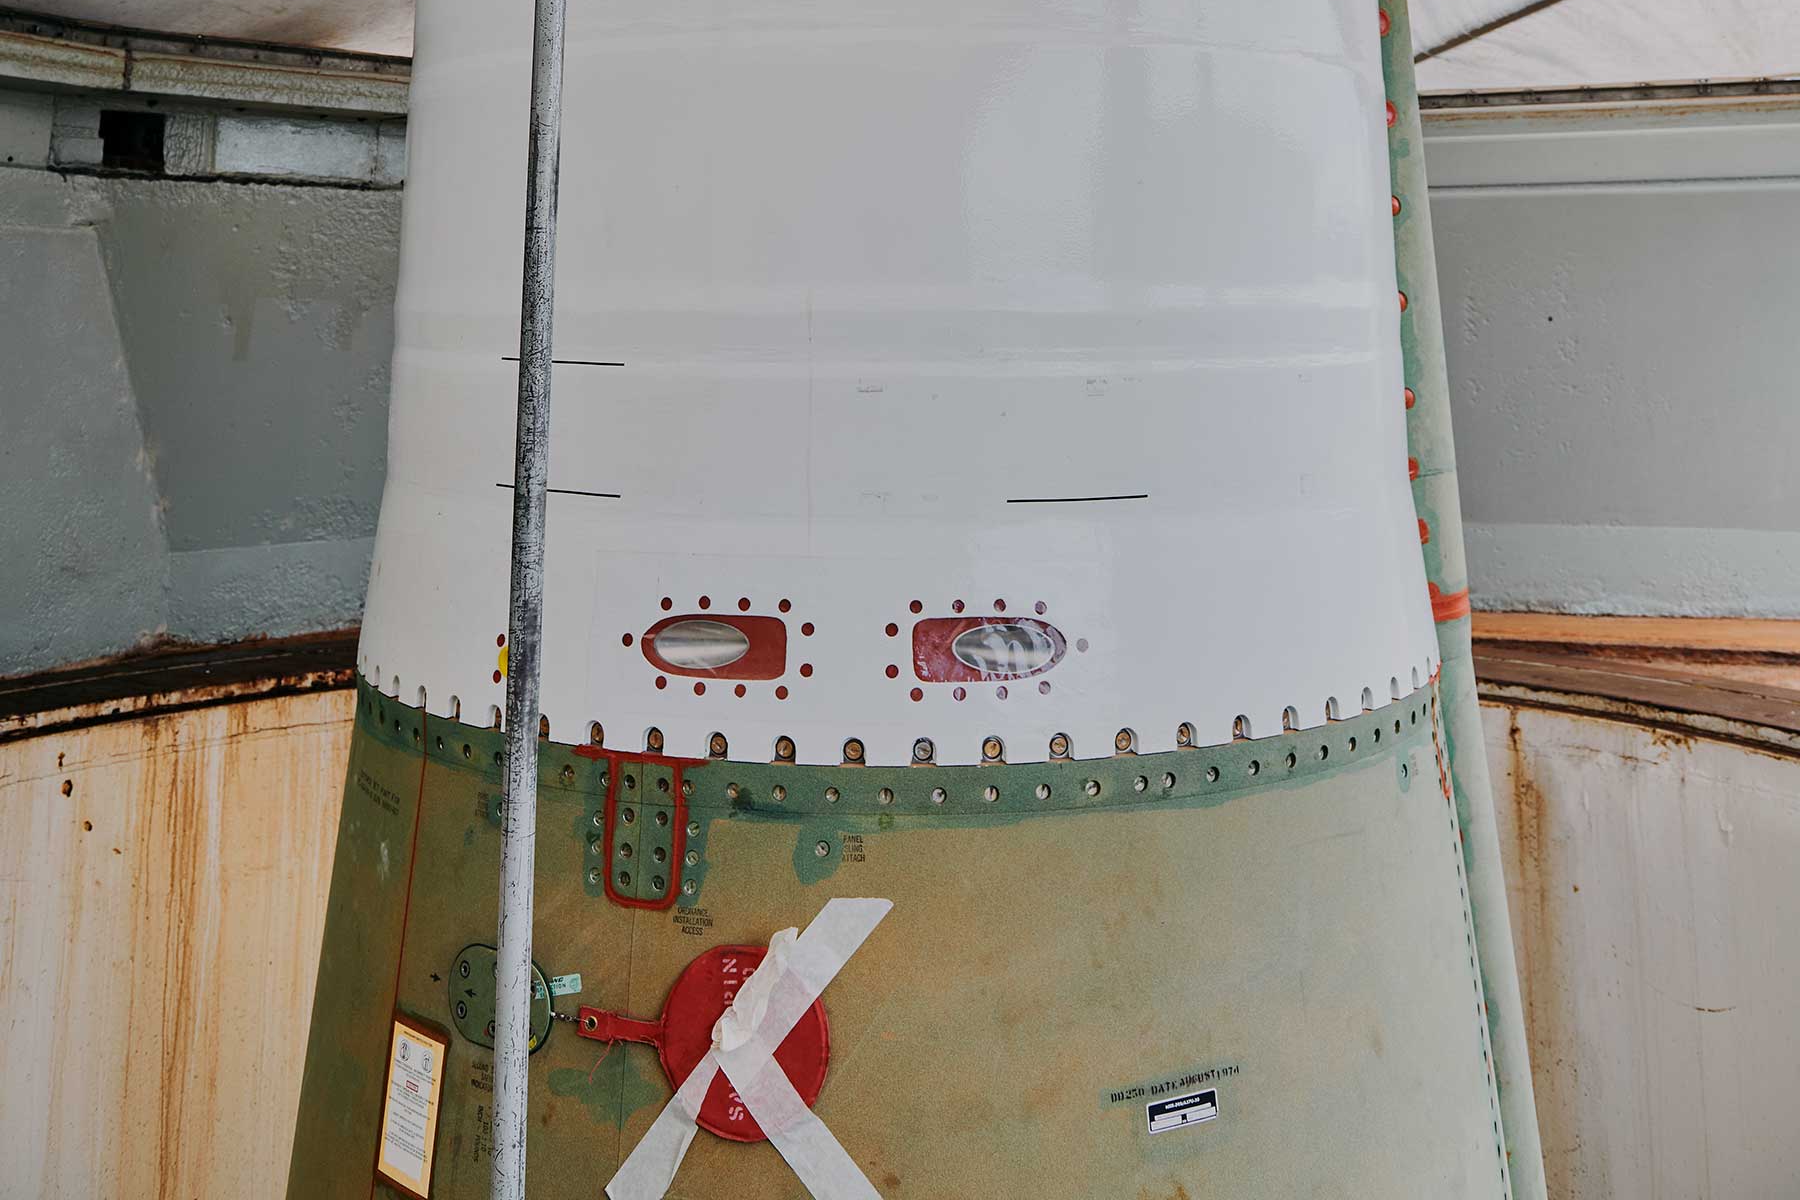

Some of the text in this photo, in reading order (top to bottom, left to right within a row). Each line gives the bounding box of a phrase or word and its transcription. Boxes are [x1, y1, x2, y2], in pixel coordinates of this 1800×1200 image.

[672, 915, 713, 927] INSTALLATION
[681, 926, 704, 936] ACCESS
[1150, 1080, 1178, 1096] DATE
